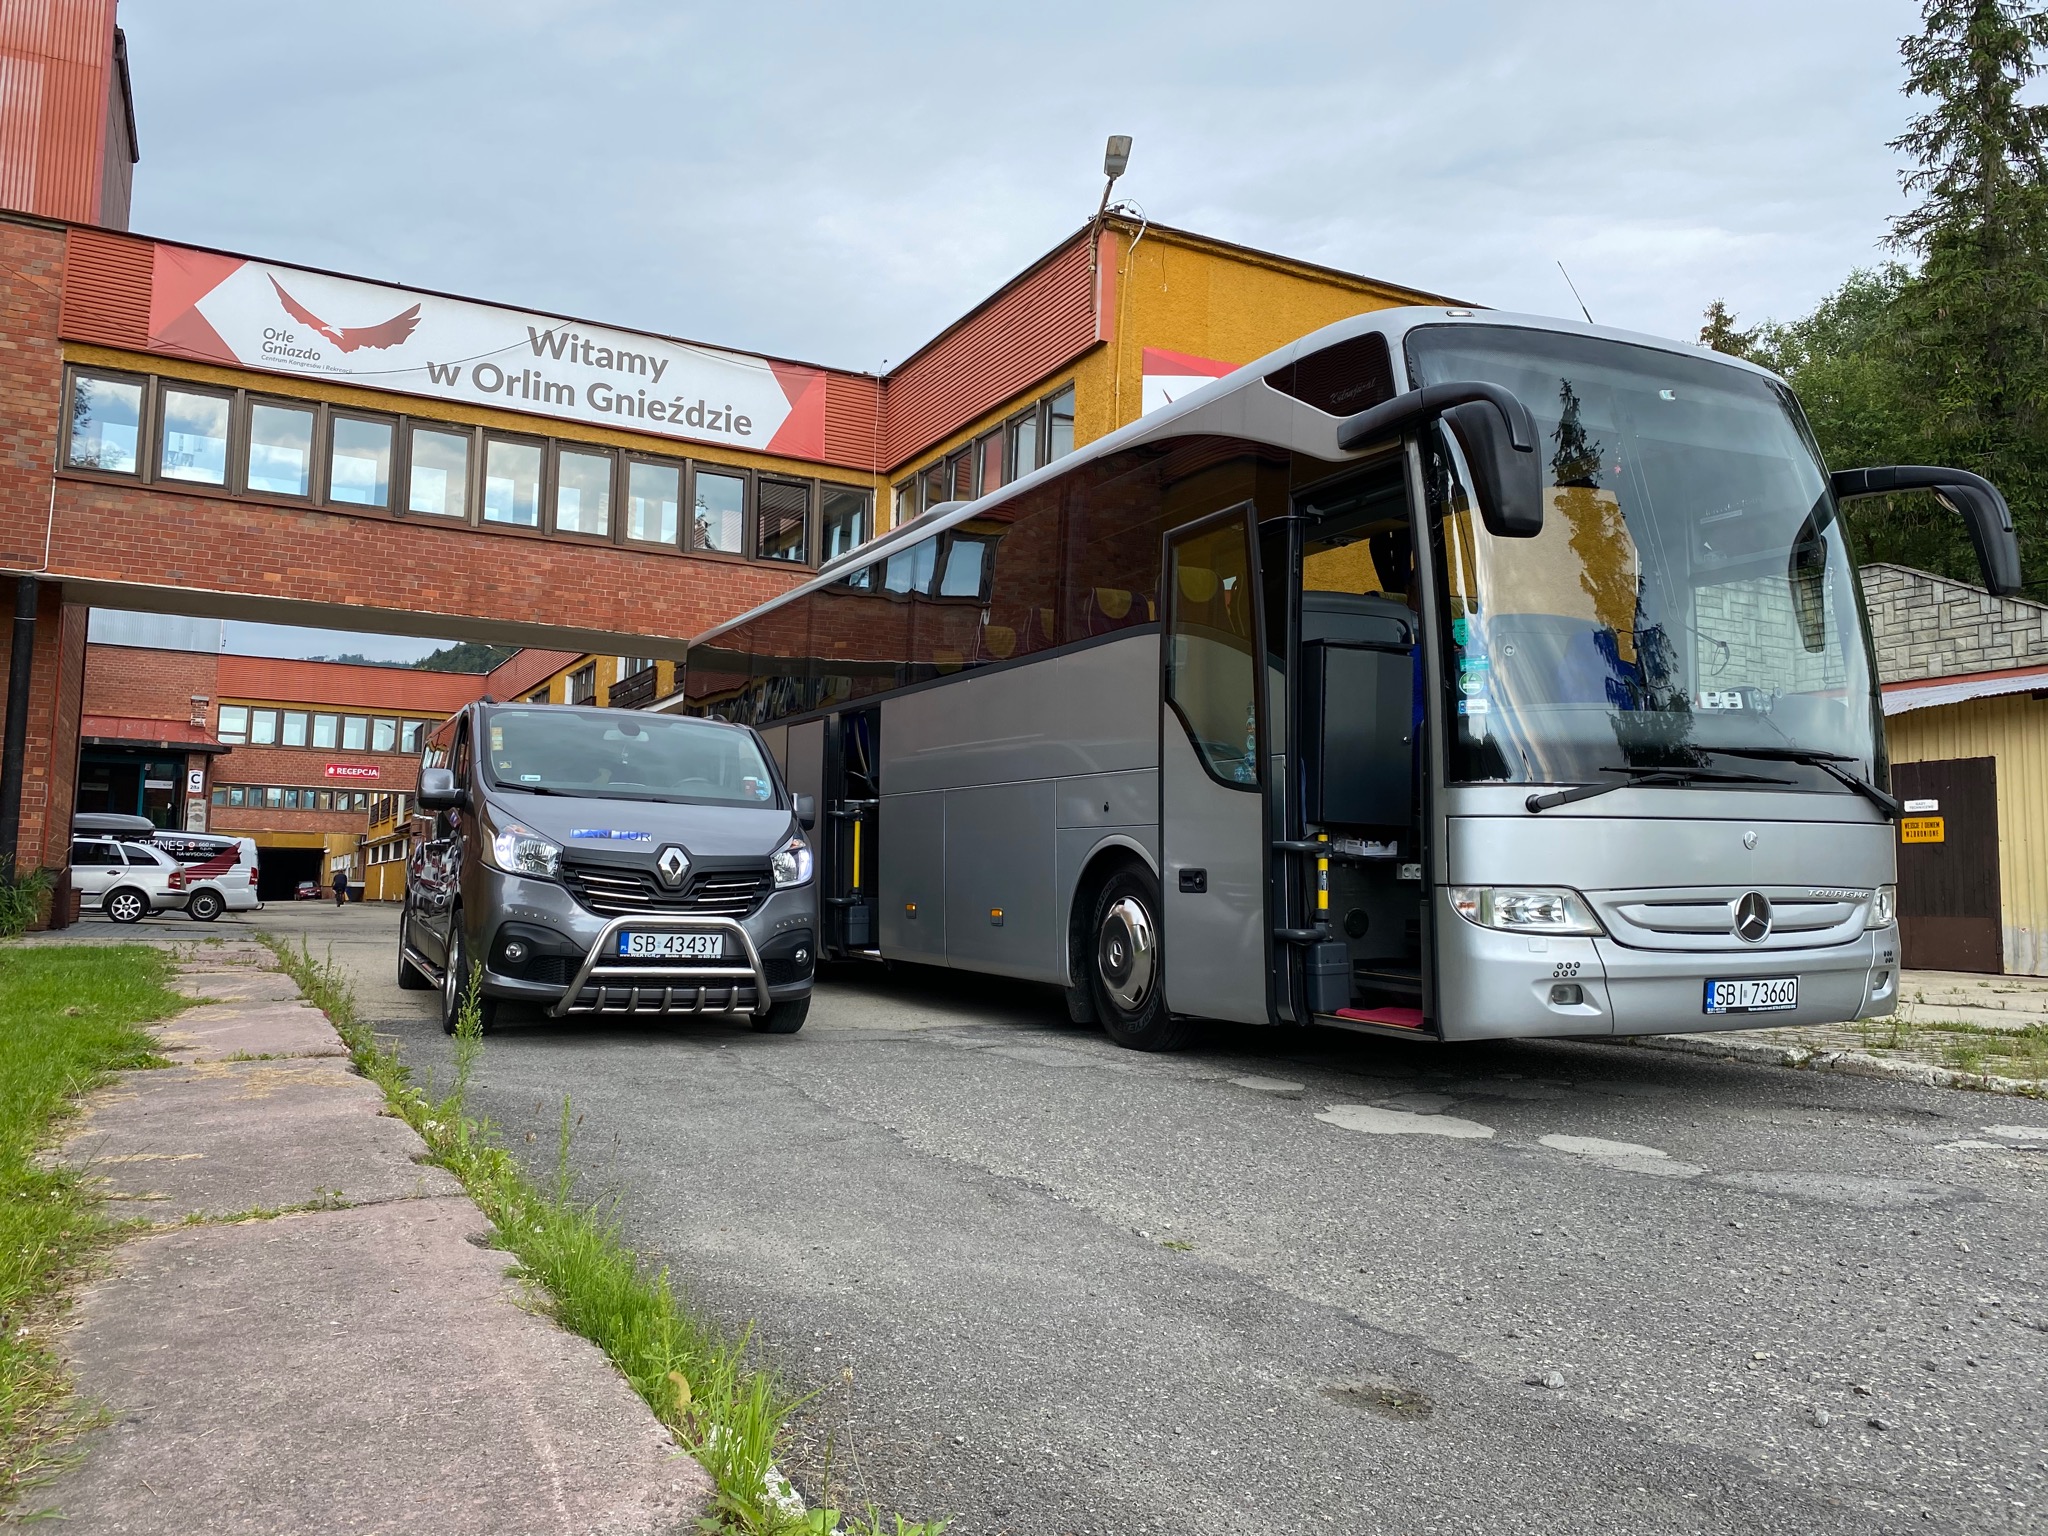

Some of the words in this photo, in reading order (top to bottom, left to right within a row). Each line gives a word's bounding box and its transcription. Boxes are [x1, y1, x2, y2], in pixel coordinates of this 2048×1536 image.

[262, 327, 295, 344] Orle
[260, 354, 288, 364] Centrum
[262, 340, 321, 361] Gniazdo
[526, 325, 669, 384] Witamy
[426, 361, 462, 387] w
[471, 362, 575, 407] Orlim
[586, 381, 753, 436] Gnieździe
[190, 773, 201, 785] C
[336, 767, 378, 777] RECEPCJA
[1808, 889, 1870, 899] TOURISMO
[632, 935, 656, 953] SB
[663, 935, 719, 954] 4343Y
[1715, 983, 1743, 1006] SBI
[1751, 981, 1795, 1005] 73660
